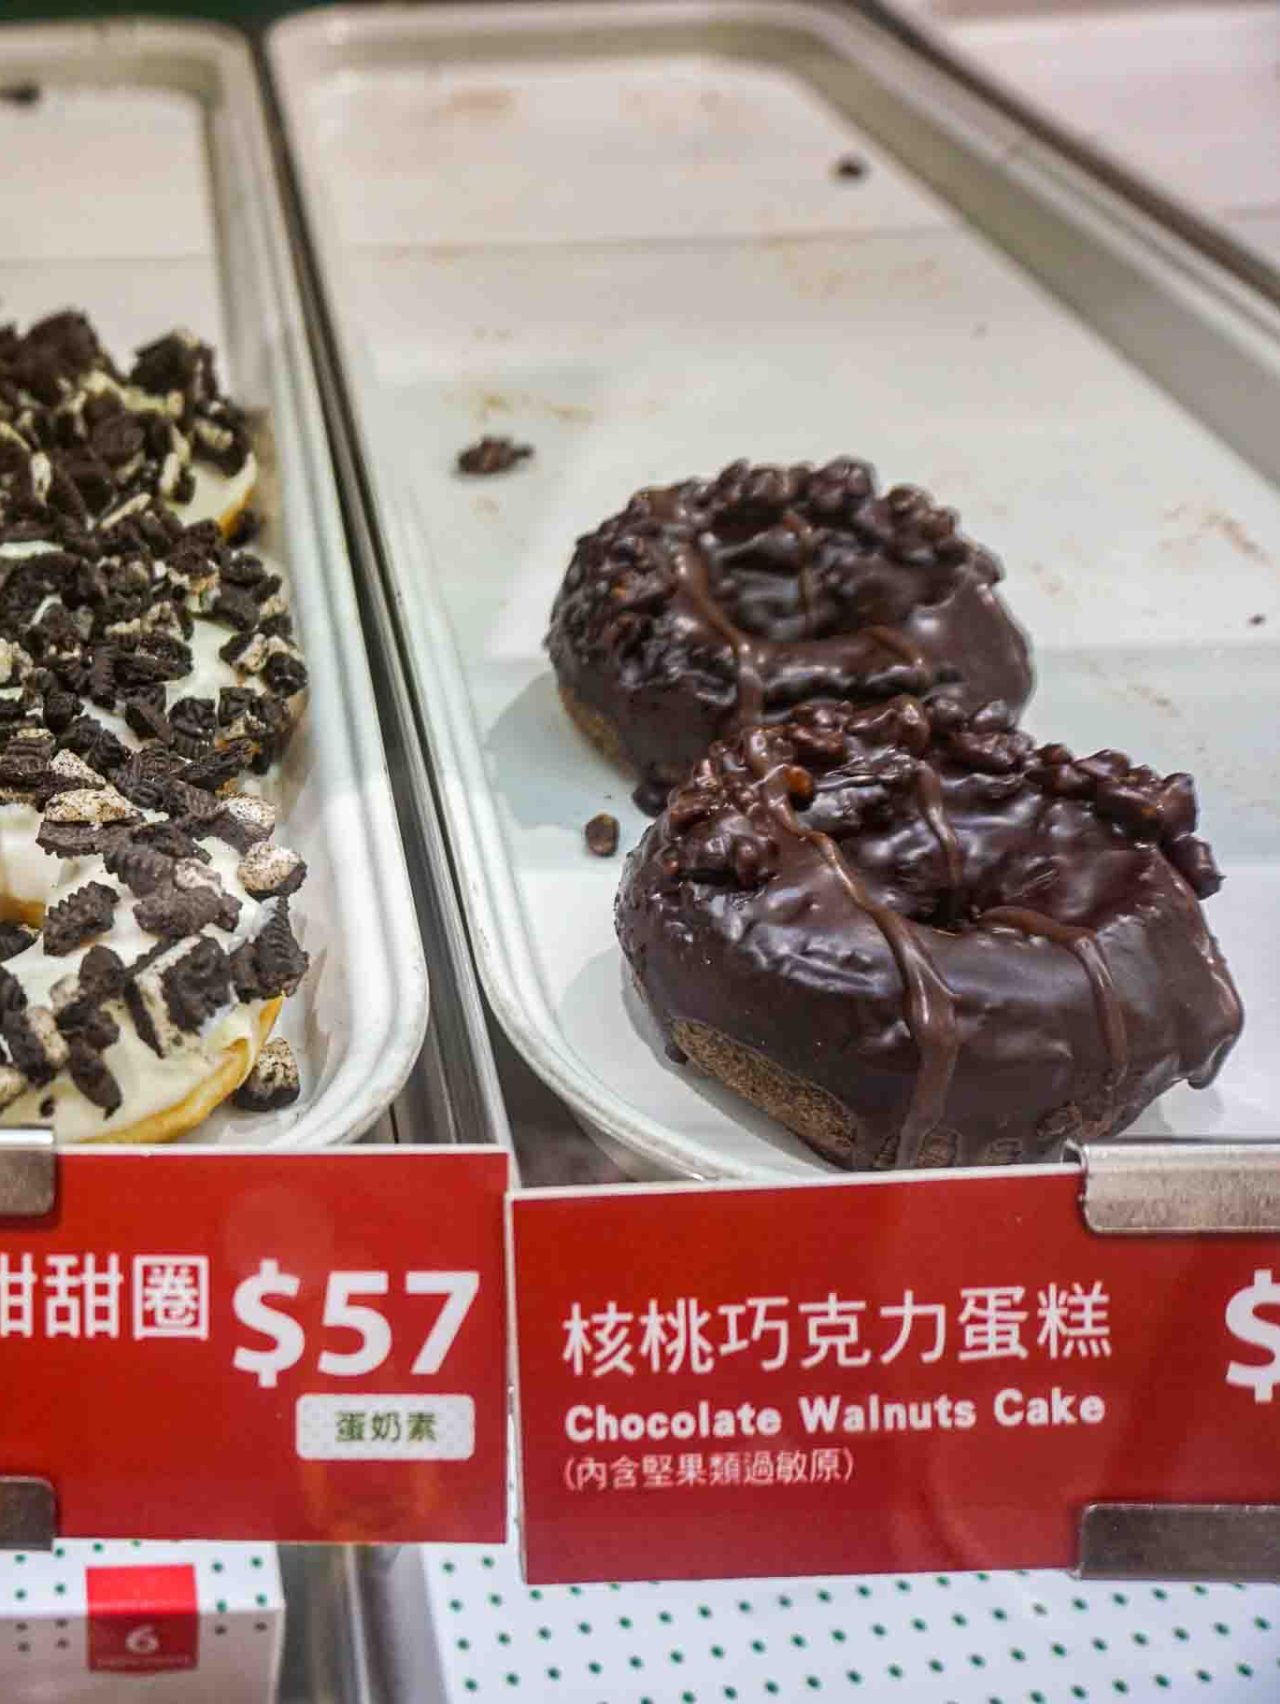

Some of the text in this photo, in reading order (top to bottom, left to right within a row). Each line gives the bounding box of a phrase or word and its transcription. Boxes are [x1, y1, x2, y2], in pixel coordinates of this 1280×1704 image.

[232, 1258, 481, 1388] $57
[562, 1280, 1112, 1378] 核桃巧克力蛋糕
[336, 1411, 437, 1442] 蛋奶素
[564, 1387, 1106, 1443] Chocolate Walnuts Cake
[125, 1625, 159, 1654] 6
